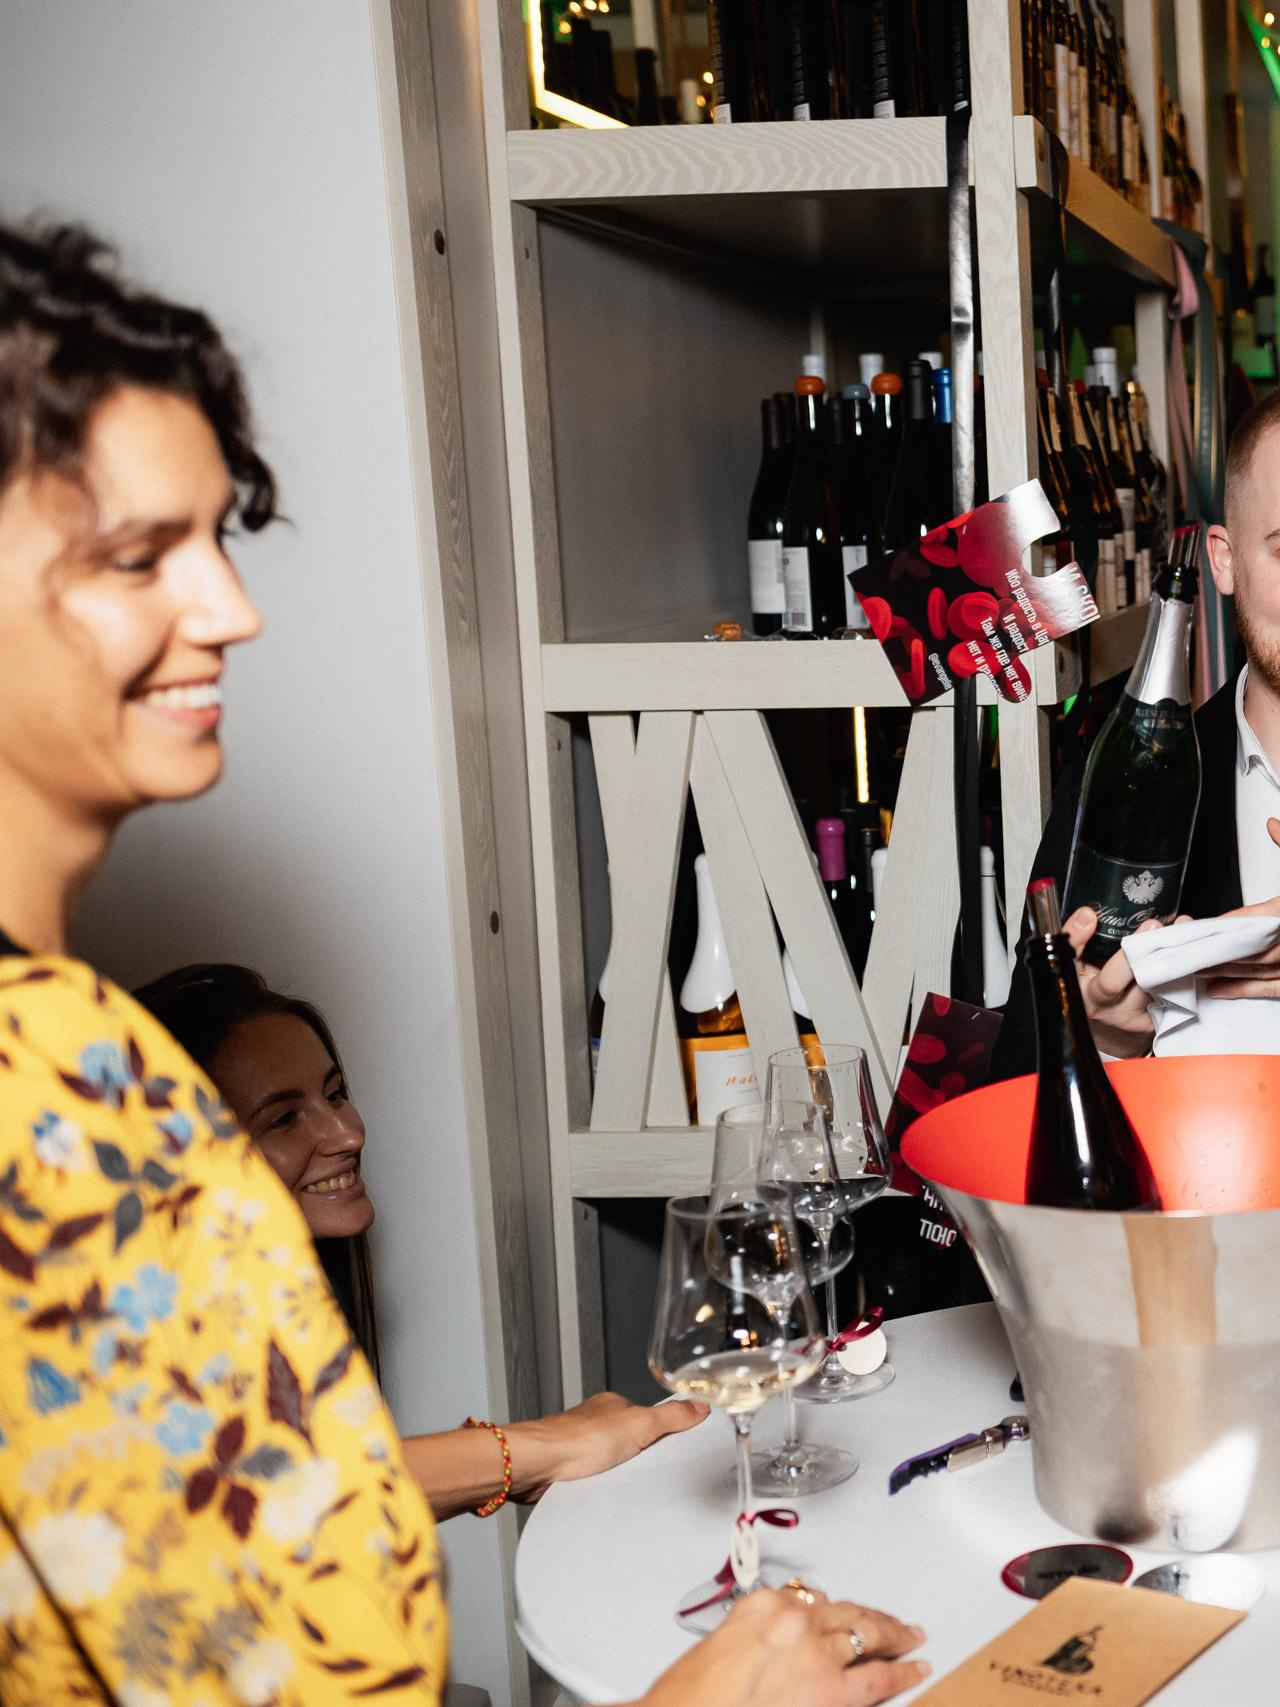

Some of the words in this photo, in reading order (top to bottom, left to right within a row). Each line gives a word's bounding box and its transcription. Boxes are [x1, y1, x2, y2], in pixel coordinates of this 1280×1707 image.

[1004, 567, 1024, 589] Ибо
[1012, 586, 1038, 624] радость
[980, 616, 996, 637] Там
[1003, 613, 1016, 624] И
[1032, 621, 1042, 631] в
[989, 634, 1003, 651] же
[966, 639, 982, 657] нет
[975, 655, 986, 665] и
[995, 649, 1010, 666] где
[1003, 664, 1018, 681] нет
